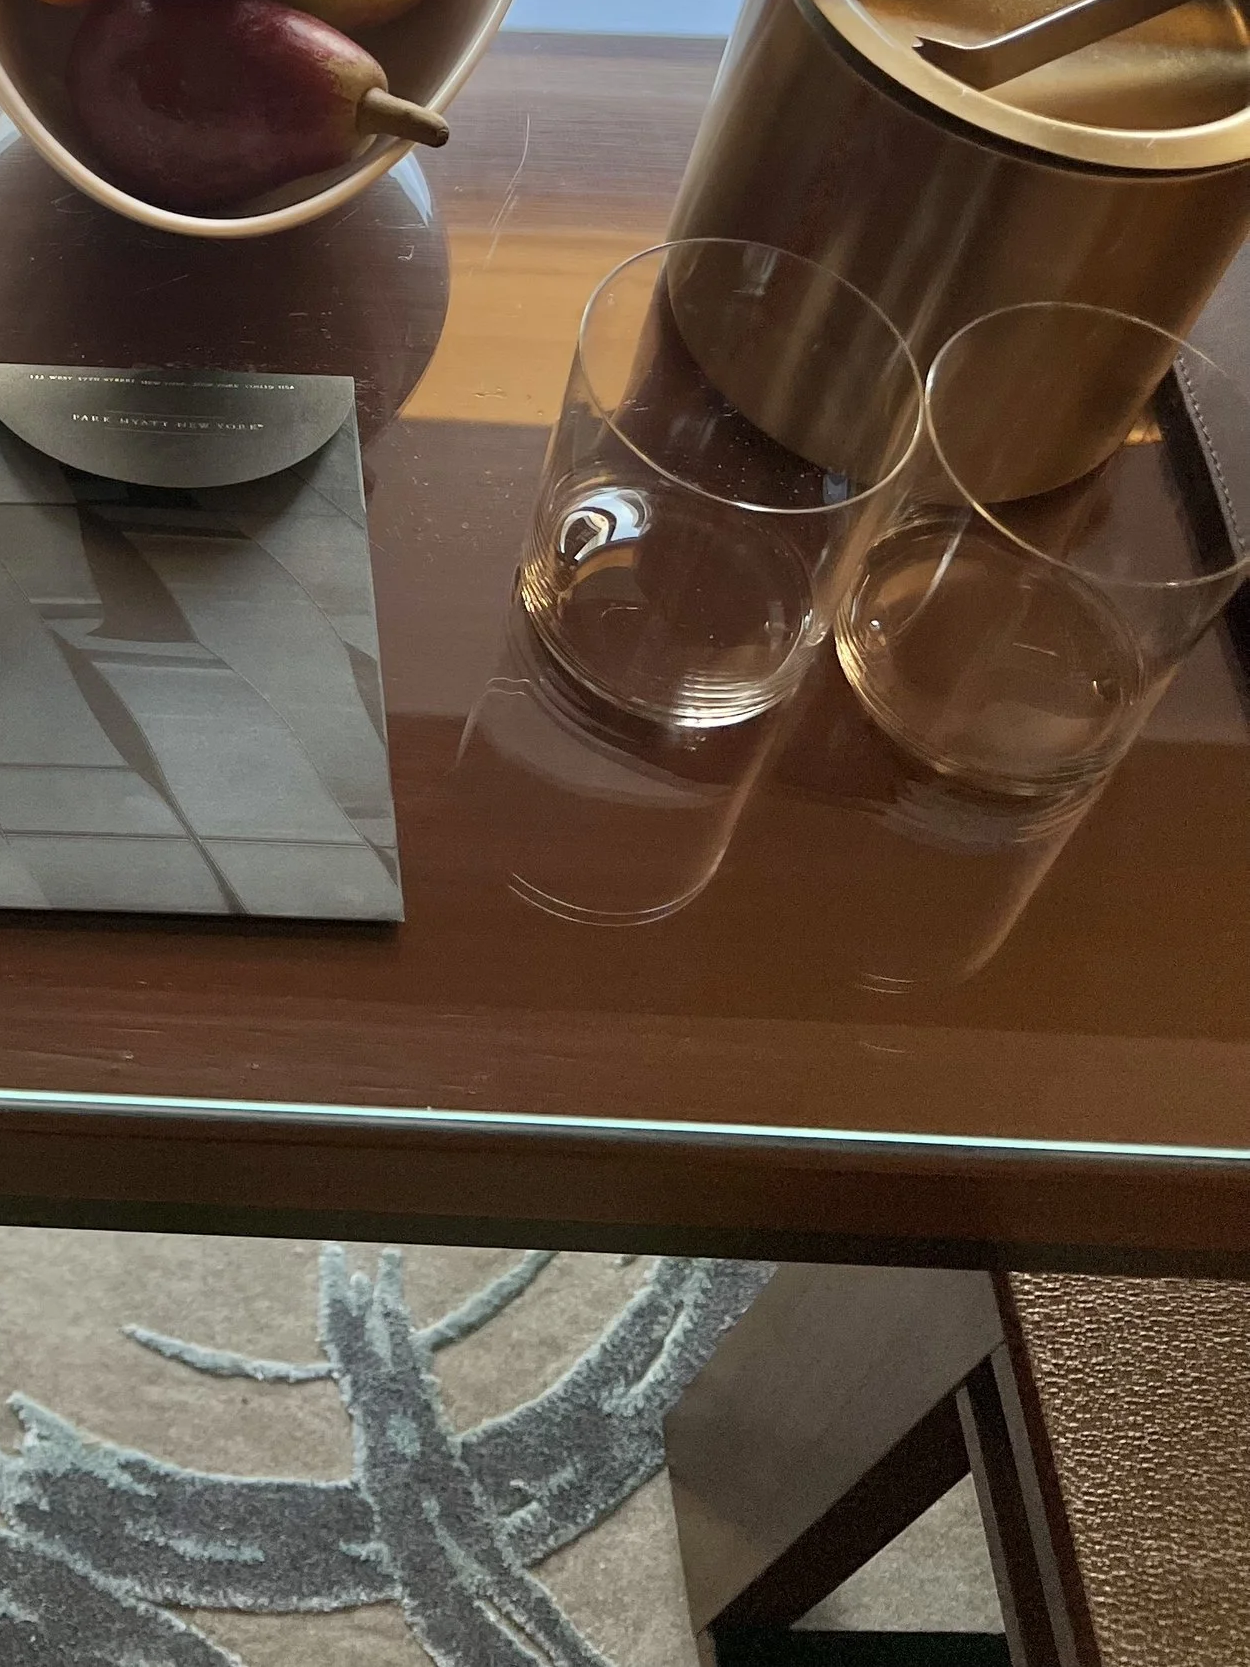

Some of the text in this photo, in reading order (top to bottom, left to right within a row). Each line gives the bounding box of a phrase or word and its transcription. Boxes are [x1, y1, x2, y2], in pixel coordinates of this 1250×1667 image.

[72, 413, 110, 423] PARK
[119, 416, 168, 428] HYATT
[176, 421, 210, 430] NEW
